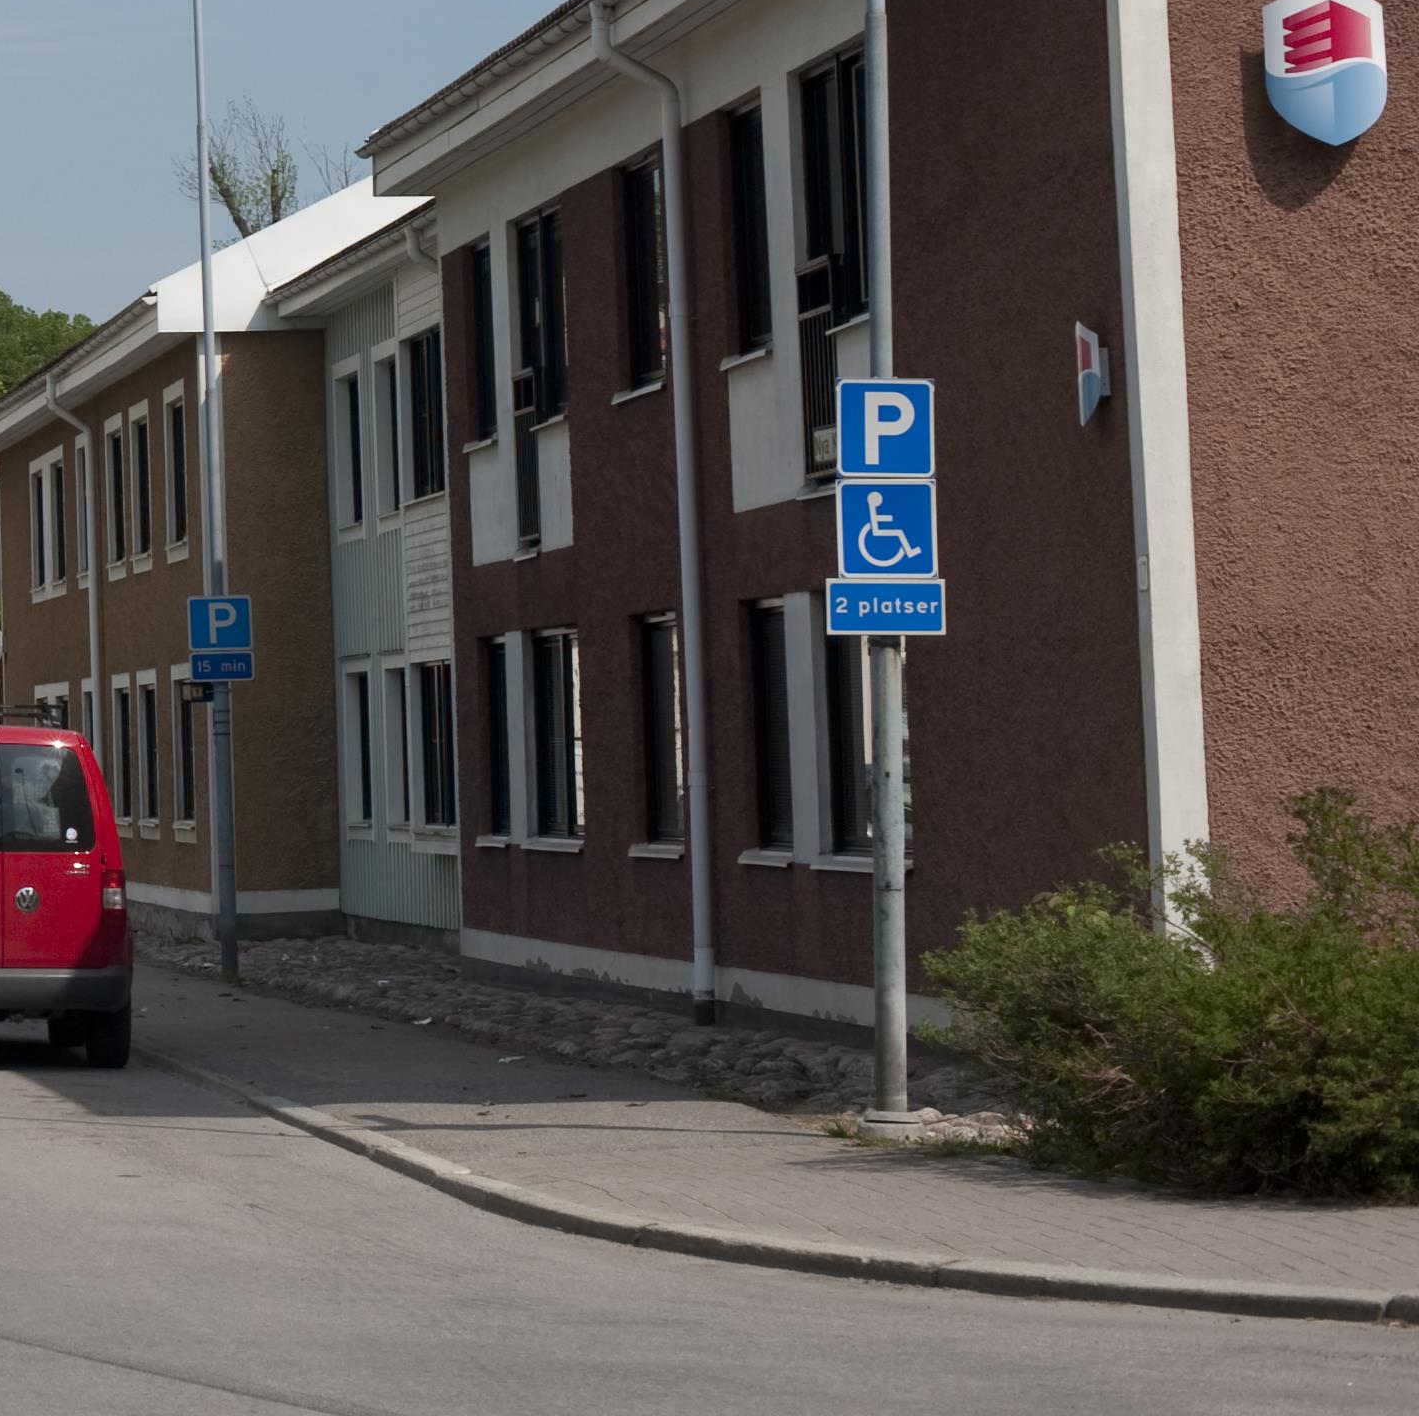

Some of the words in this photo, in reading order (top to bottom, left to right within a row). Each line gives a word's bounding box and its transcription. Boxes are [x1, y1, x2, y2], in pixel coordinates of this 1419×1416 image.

[865, 391, 915, 465] P
[836, 597, 848, 614] 2
[859, 597, 939, 617] platser
[208, 602, 237, 644] P
[197, 660, 211, 673] 15
[221, 659, 246, 672] min
